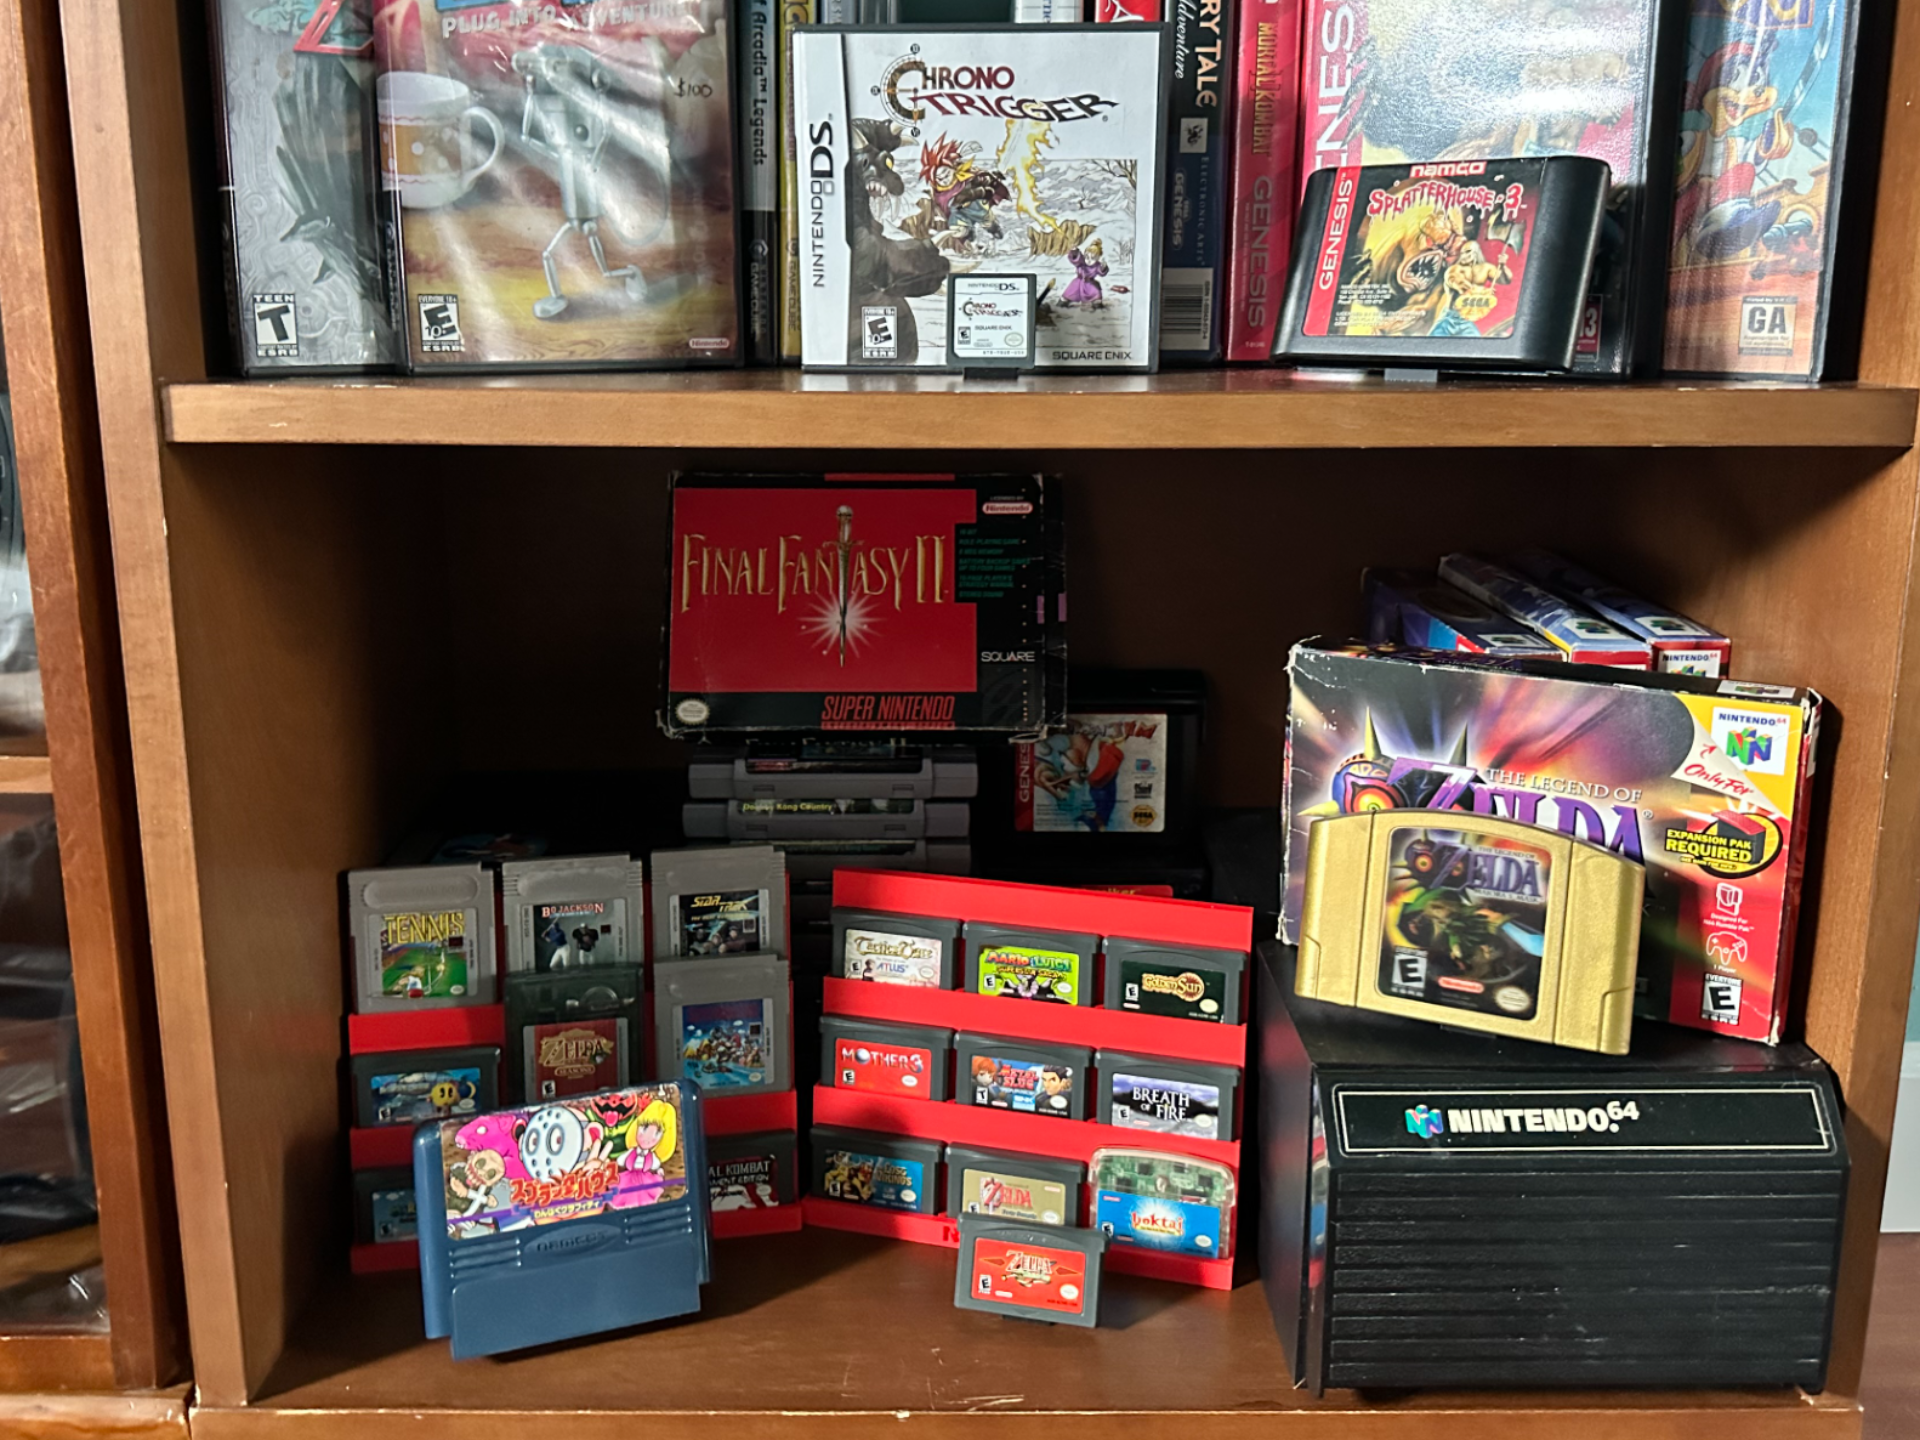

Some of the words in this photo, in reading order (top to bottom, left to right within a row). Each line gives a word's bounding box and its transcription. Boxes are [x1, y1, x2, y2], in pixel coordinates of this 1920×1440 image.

[442, 12, 499, 38] PLUG
[1195, 39, 1222, 107] TALE
[674, 78, 713, 98] $100
[884, 58, 1015, 122] CHRONO
[908, 93, 1119, 123] TRIGGER
[750, 100, 767, 165] Legends
[809, 120, 834, 179] DS
[1411, 162, 1485, 177] namco
[1197, 156, 1210, 229] ELECTRONIC
[1367, 181, 1495, 217] SPLATTERHOUSE
[1502, 183, 1524, 219] 3
[1172, 173, 1185, 247] GENESIS
[811, 180, 825, 288] NINTENDO
[1248, 175, 1274, 328] GENESIS
[254, 295, 294, 303] TEEN
[999, 283, 1016, 291] DS
[1461, 297, 1490, 308] SEGA
[257, 305, 290, 342] T
[424, 304, 457, 339] E
[868, 317, 892, 344] E
[1748, 306, 1787, 334] GA
[258, 349, 298, 357] ESRB
[1052, 351, 1103, 361] SQUARE
[1105, 351, 1131, 361] ENIX
[986, 504, 1030, 512] Nintendo
[681, 533, 774, 614] FINAL
[777, 534, 912, 614] FANTASY
[915, 534, 946, 604] II
[980, 651, 1035, 662] SQUARE
[1663, 653, 1709, 663] NINTENDO
[822, 695, 875, 721] SUPER
[877, 695, 956, 722] NINTENDO
[1718, 712, 1776, 727] NINTENDO
[1776, 717, 1788, 725] 64
[1019, 743, 1030, 803] GENES
[1486, 768, 1525, 788] THE
[1530, 775, 1610, 800] LEGEND
[1612, 787, 1642, 803] OF
[1684, 763, 1726, 789] Only
[1722, 778, 1754, 796] For
[776, 803, 798, 813] Kong
[799, 803, 833, 812] Country
[1665, 839, 1752, 863] REQUIRED
[1666, 828, 1728, 845] EXPANSION
[1729, 838, 1752, 850] PAK
[1494, 848, 1523, 859] LEGEND
[1430, 841, 1542, 897] ZELDA
[559, 902, 604, 914] JACKSON
[690, 895, 721, 908] STAR
[384, 912, 465, 944] TENNIS
[876, 962, 906, 974] ATLUS
[986, 951, 1030, 966] MARIO
[1398, 958, 1422, 983] E
[1176, 977, 1202, 993] Sun
[1705, 974, 1742, 986] EVERYONE
[1709, 986, 1735, 1011] E
[841, 1047, 908, 1069] MOTHER
[909, 1053, 924, 1074] 3
[1132, 1086, 1191, 1108] BREATH
[1140, 1102, 1151, 1112] OF
[1156, 1104, 1187, 1124] FIRE
[1447, 1107, 1610, 1134] NINTENDO
[1606, 1100, 1640, 1121] 64
[726, 1160, 771, 1176] KOMBAT
[737, 1174, 770, 1185] EDITION
[983, 1179, 1034, 1209] ZELDA
[1005, 1249, 1053, 1275] ZELDA
